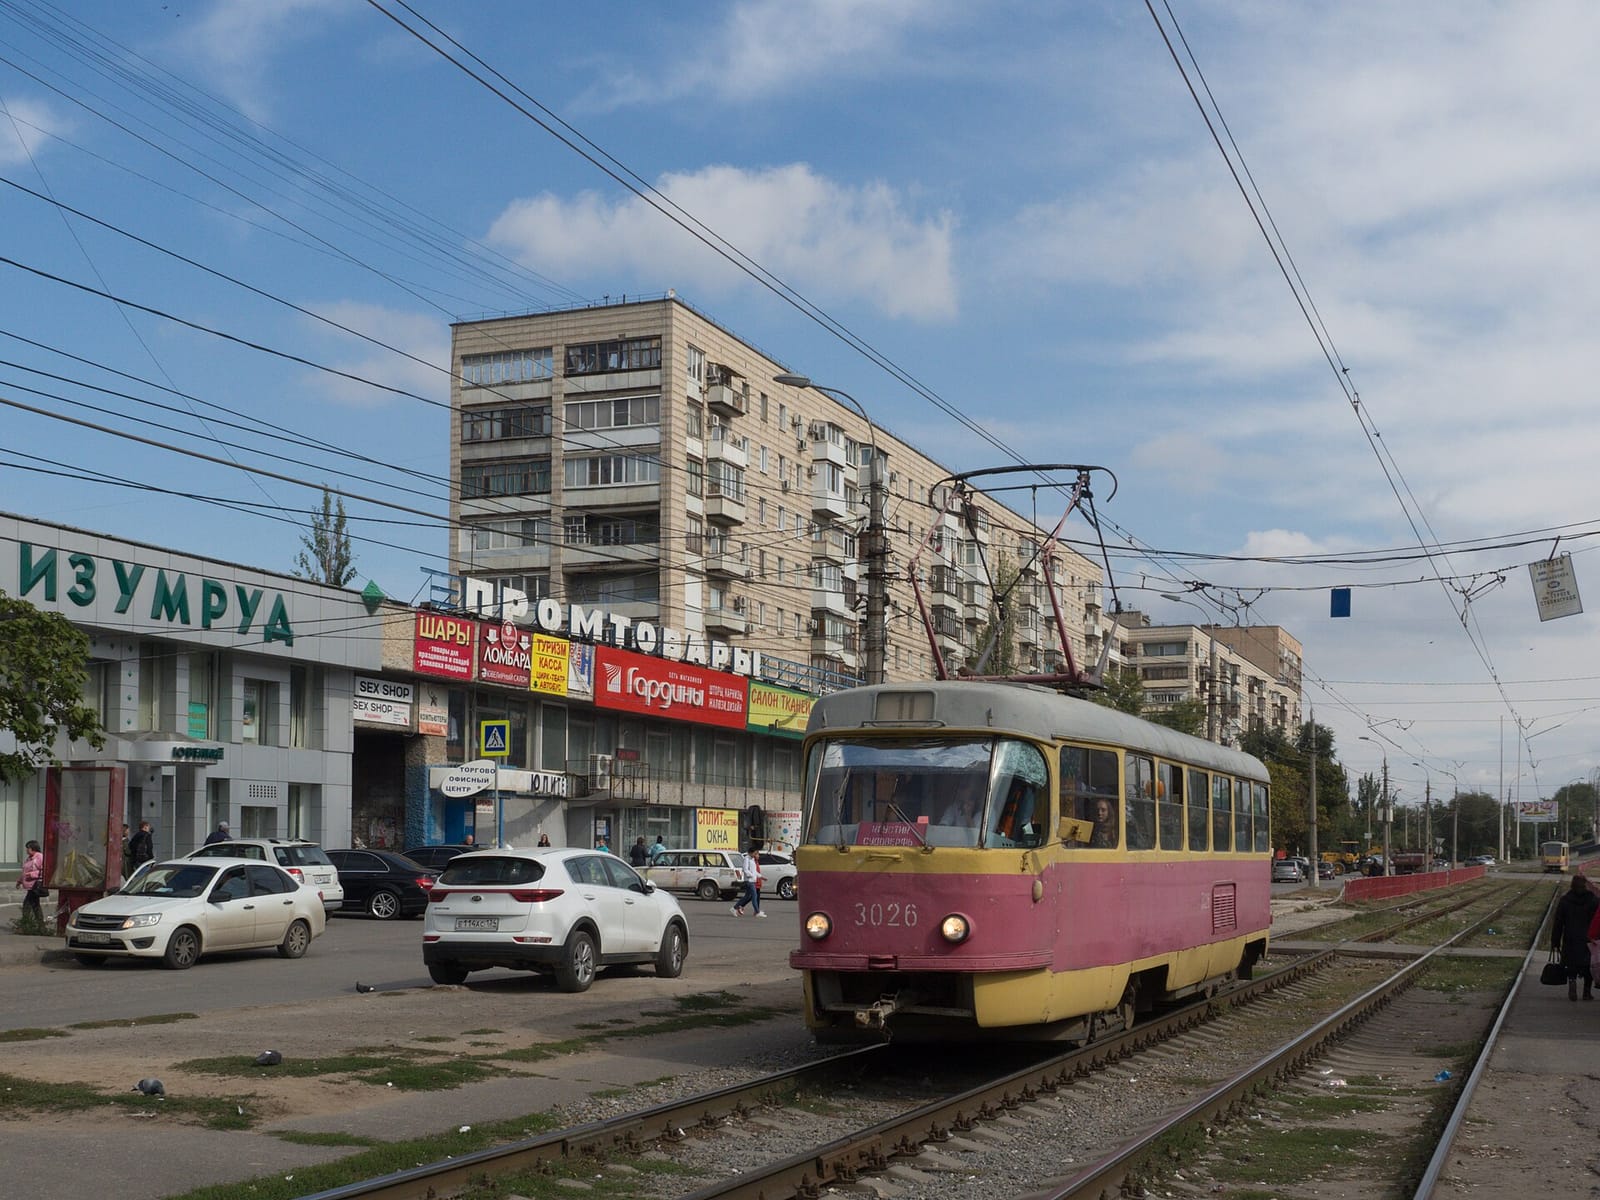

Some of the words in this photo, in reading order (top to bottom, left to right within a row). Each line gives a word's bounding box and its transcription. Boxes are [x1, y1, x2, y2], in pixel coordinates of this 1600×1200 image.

[20, 541, 294, 647] ИЗУМРУД
[420, 615, 470, 646] ШАРЫ
[465, 576, 761, 677] ПРОМТОВАРЫ
[536, 638, 566, 656] ТУРИЗМ
[484, 646, 532, 671] ЛОМБАРД
[539, 657, 563, 672] КАССА
[360, 681, 380, 694] SEX
[382, 684, 409, 698] SHOP
[353, 700, 369, 711] SEX
[370, 703, 393, 714] SHOP
[751, 688, 778, 708] САЛОН
[782, 695, 811, 715] ТКАНЕЙ
[460, 766, 496, 774] ТОРГОВО
[448, 776, 489, 784] ОФИСНЫЙ
[445, 785, 472, 793] ЦЕНТР
[697, 810, 724, 826] СПЛИТ
[706, 829, 729, 844] ОКНА
[855, 902, 918, 927] 3026
